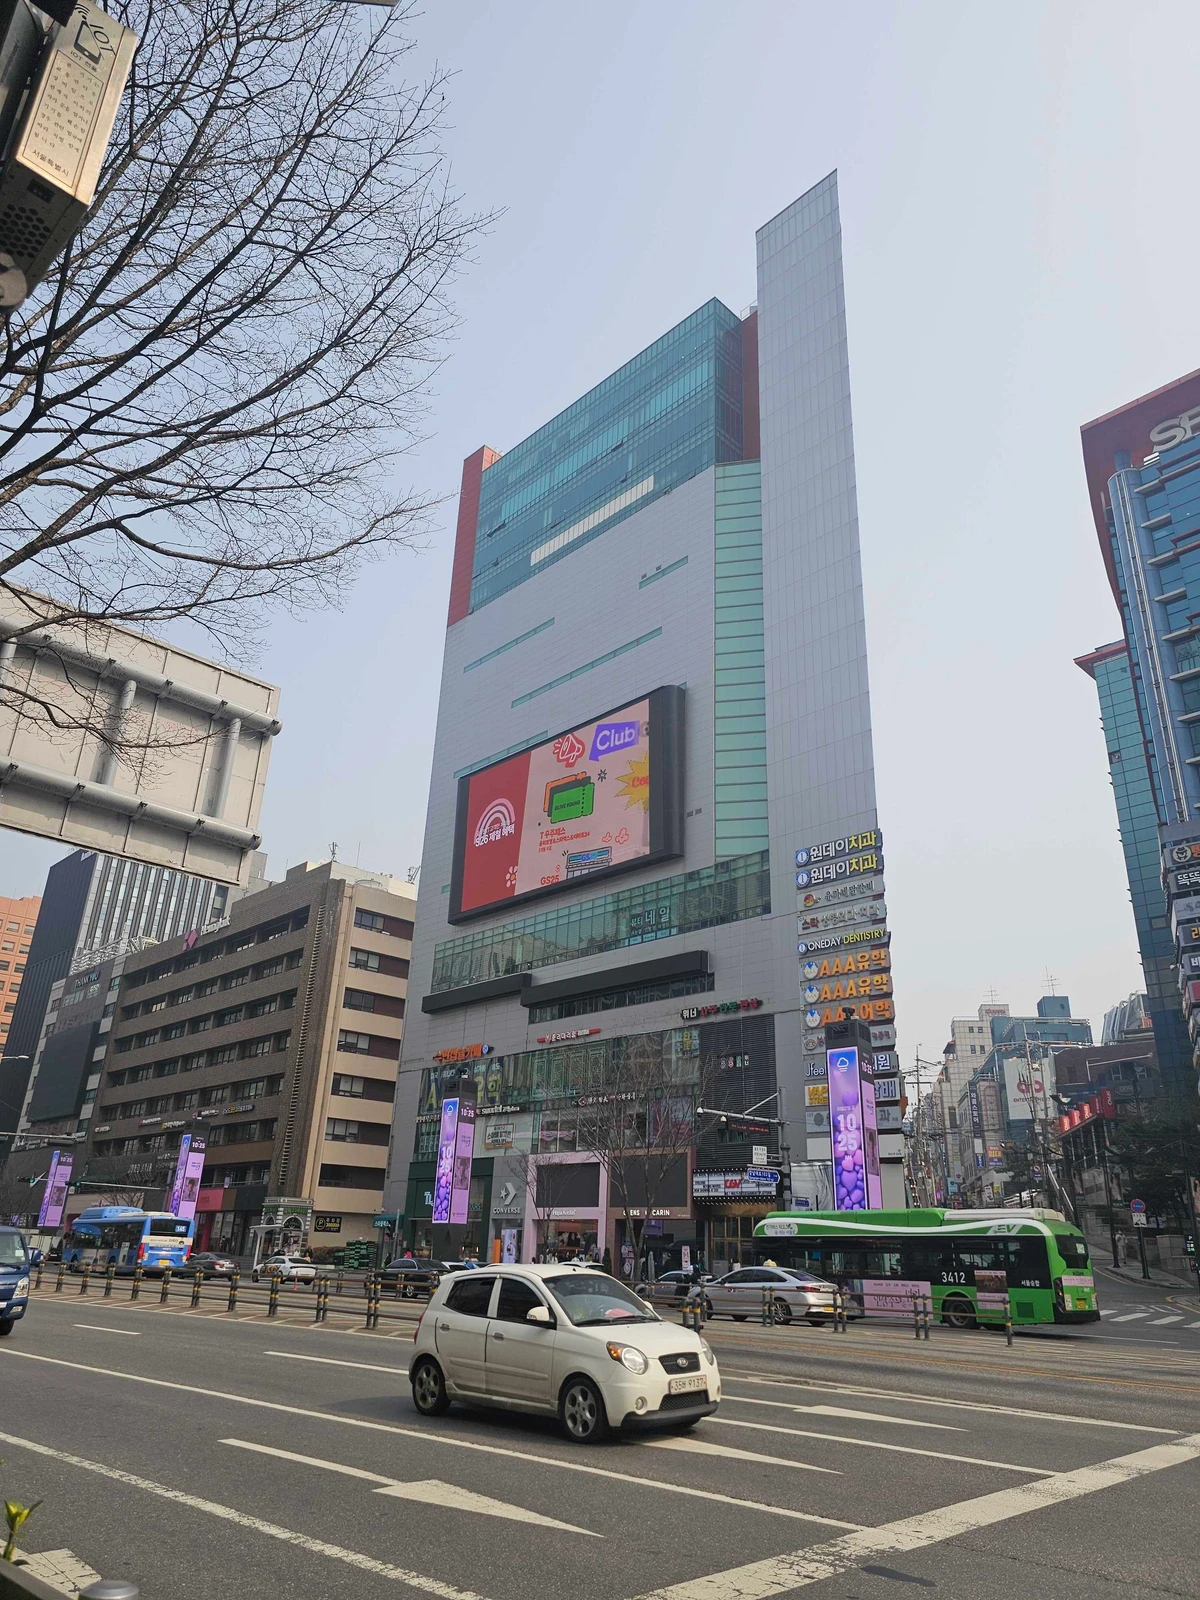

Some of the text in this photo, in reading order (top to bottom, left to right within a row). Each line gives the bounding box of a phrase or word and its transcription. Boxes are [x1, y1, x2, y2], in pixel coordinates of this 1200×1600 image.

[596, 726, 636, 751] Club
[809, 831, 877, 862] 원데이치과
[810, 854, 878, 884] 원데이치과
[540, 874, 560, 886] GS25
[808, 927, 886, 951] ONEDAY DENTISTRY
[820, 949, 886, 978] AAA유학
[821, 973, 888, 1002] AAA유학
[682, 1006, 697, 1019] 위너
[460, 1108, 474, 1118] 10:25
[836, 1112, 858, 1131] 10
[191, 1141, 206, 1149] 10:25
[837, 1132, 858, 1151] 25
[441, 1146, 452, 1158] 10
[492, 1206, 521, 1214] CONVERSE
[622, 1208, 670, 1217] OENS CARIN
[995, 1224, 1016, 1234] EV
[941, 1271, 966, 1284] 3412
[1020, 1279, 1040, 1288] 서울승합
